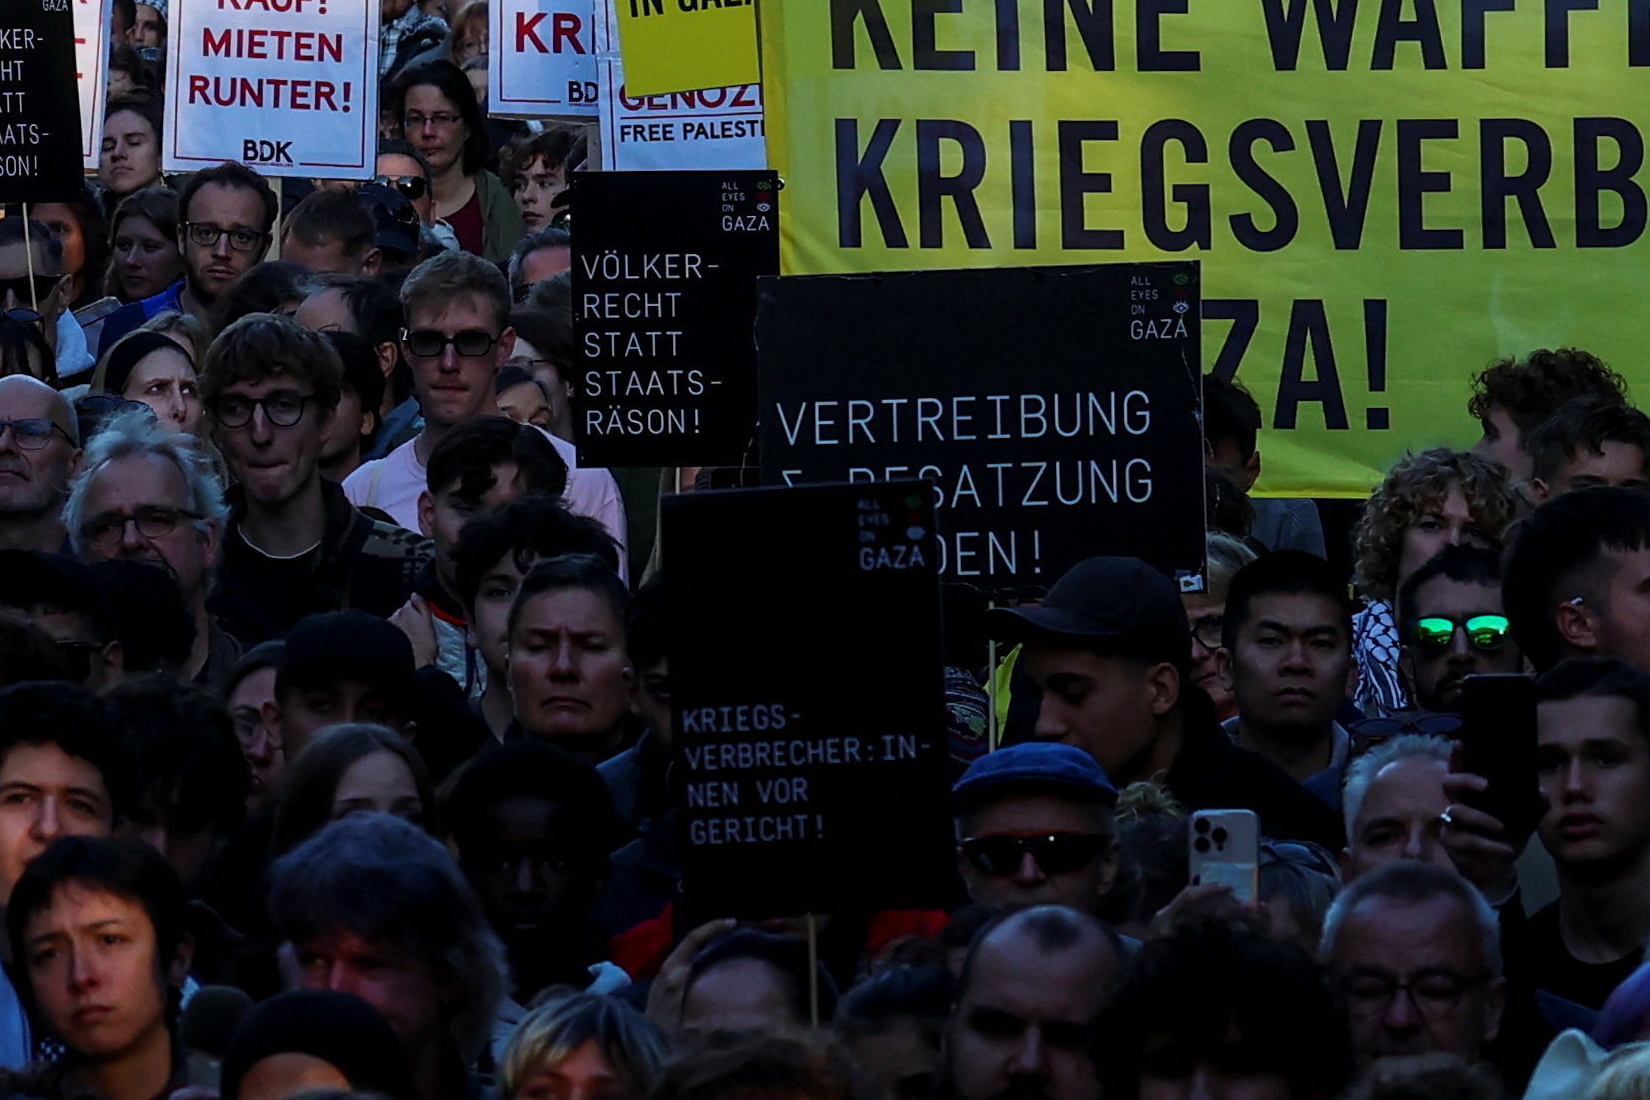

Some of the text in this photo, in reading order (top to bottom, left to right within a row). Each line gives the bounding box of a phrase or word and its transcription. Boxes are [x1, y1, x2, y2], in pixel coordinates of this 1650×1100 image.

[202, 27, 342, 63] MIETEN
[516, 12, 595, 54] KR
[188, 75, 352, 113] RUNTER!
[568, 81, 598, 102] BD
[619, 83, 763, 112] GENOZ
[620, 121, 764, 143] FREE PALESTI
[243, 139, 294, 163] BDK
[722, 182, 739, 190] ALL
[722, 193, 745, 201] EYES
[835, 117, 1648, 253] KRIEGSVERB
[722, 204, 734, 212] ON
[722, 215, 770, 232] GAZA
[581, 250, 719, 280] VÖLKER-
[1131, 275, 1151, 286] ALL
[583, 293, 682, 318] RECHT
[1131, 289, 1159, 300] EYES
[1131, 304, 1145, 315] ON
[1130, 319, 1188, 340] GAZA
[584, 332, 683, 357] STATT
[1201, 298, 1390, 430] ZA!
[585, 370, 722, 396] STAATS-
[586, 405, 700, 435] RÄSON!
[776, 390, 1151, 446] VERTREIBUNG
[859, 545, 925, 571] GAZA
[682, 704, 801, 733] KRIEGS-
[684, 734, 932, 771] VERBRECHER:IN-
[687, 777, 809, 808] NEN VOR
[690, 814, 825, 845] GERICHT!
